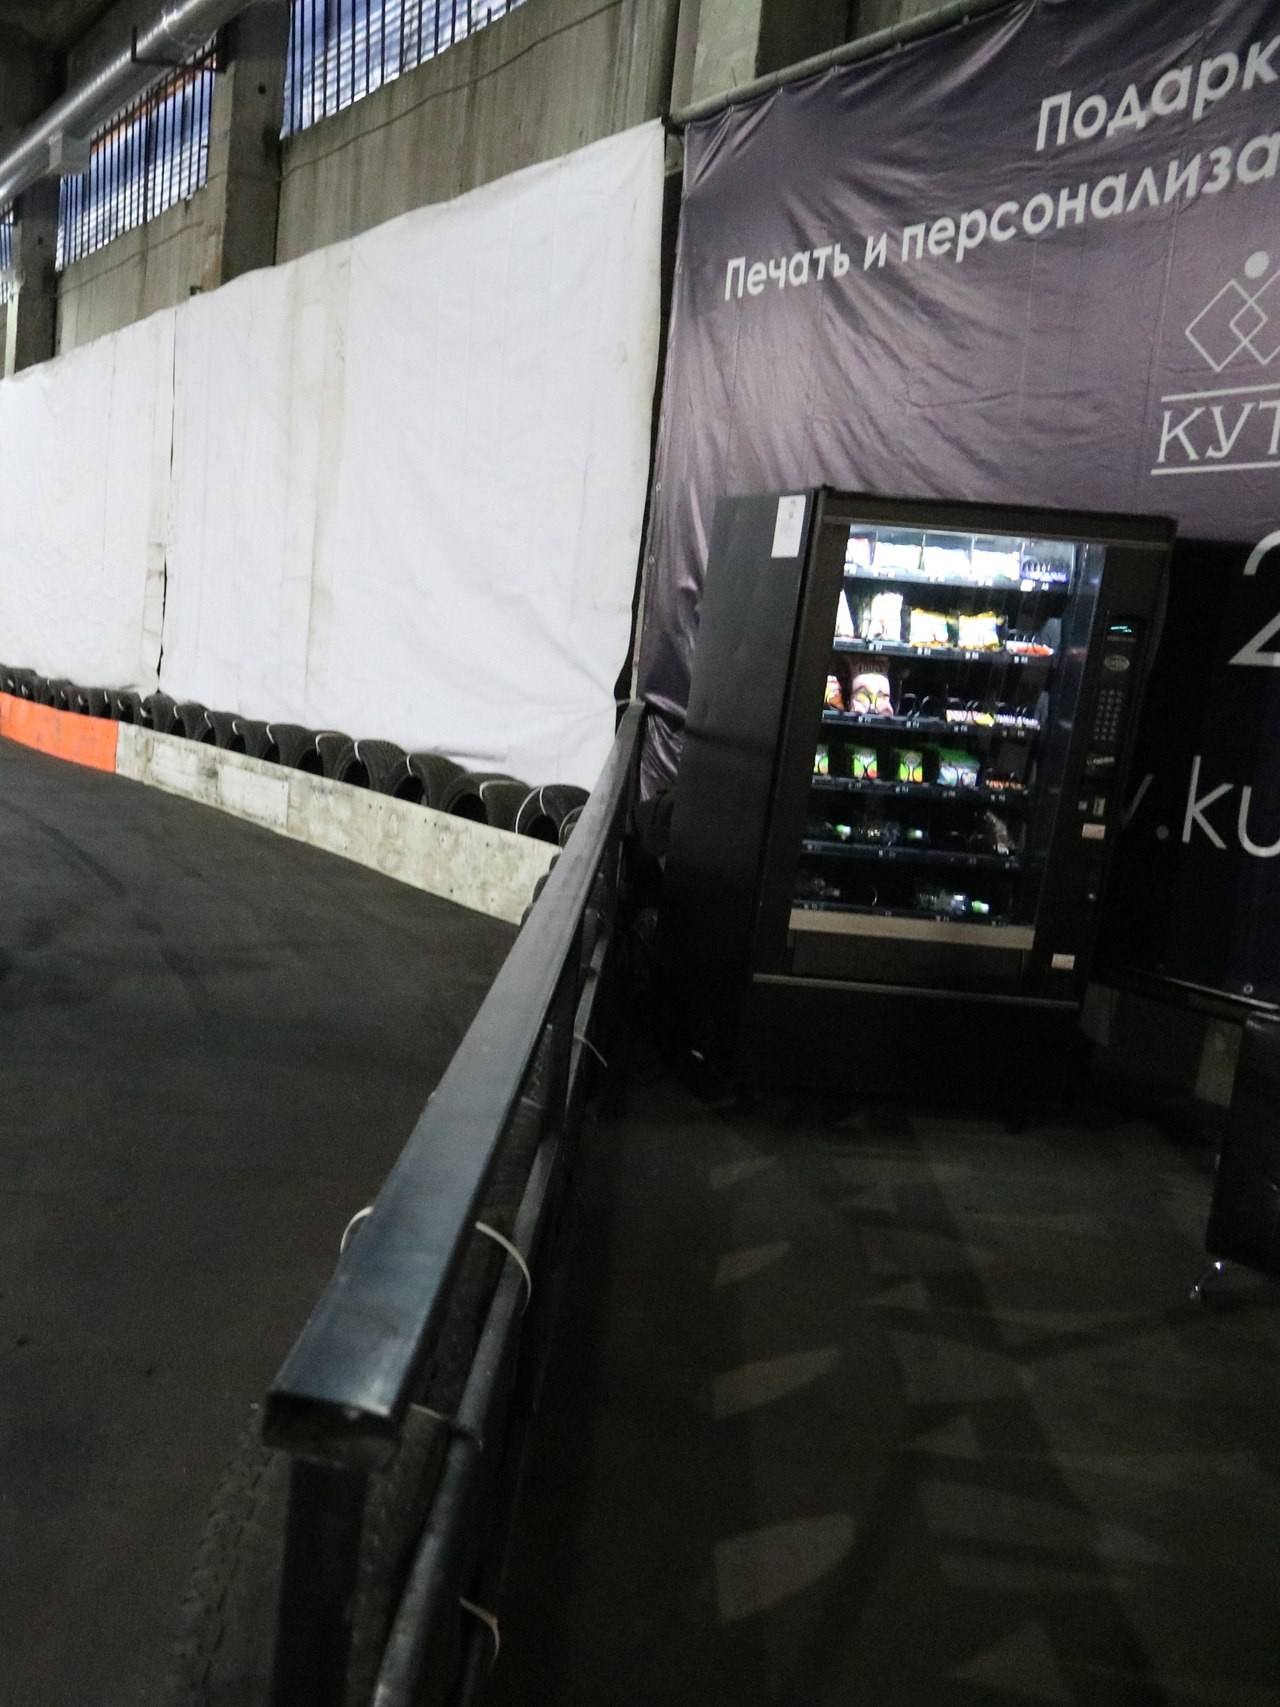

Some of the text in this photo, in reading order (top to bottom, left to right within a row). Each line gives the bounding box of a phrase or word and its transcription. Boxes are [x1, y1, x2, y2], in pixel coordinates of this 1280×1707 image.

[1036, 35, 1280, 151] Подарк
[725, 131, 1280, 301] Печать и персонализа
